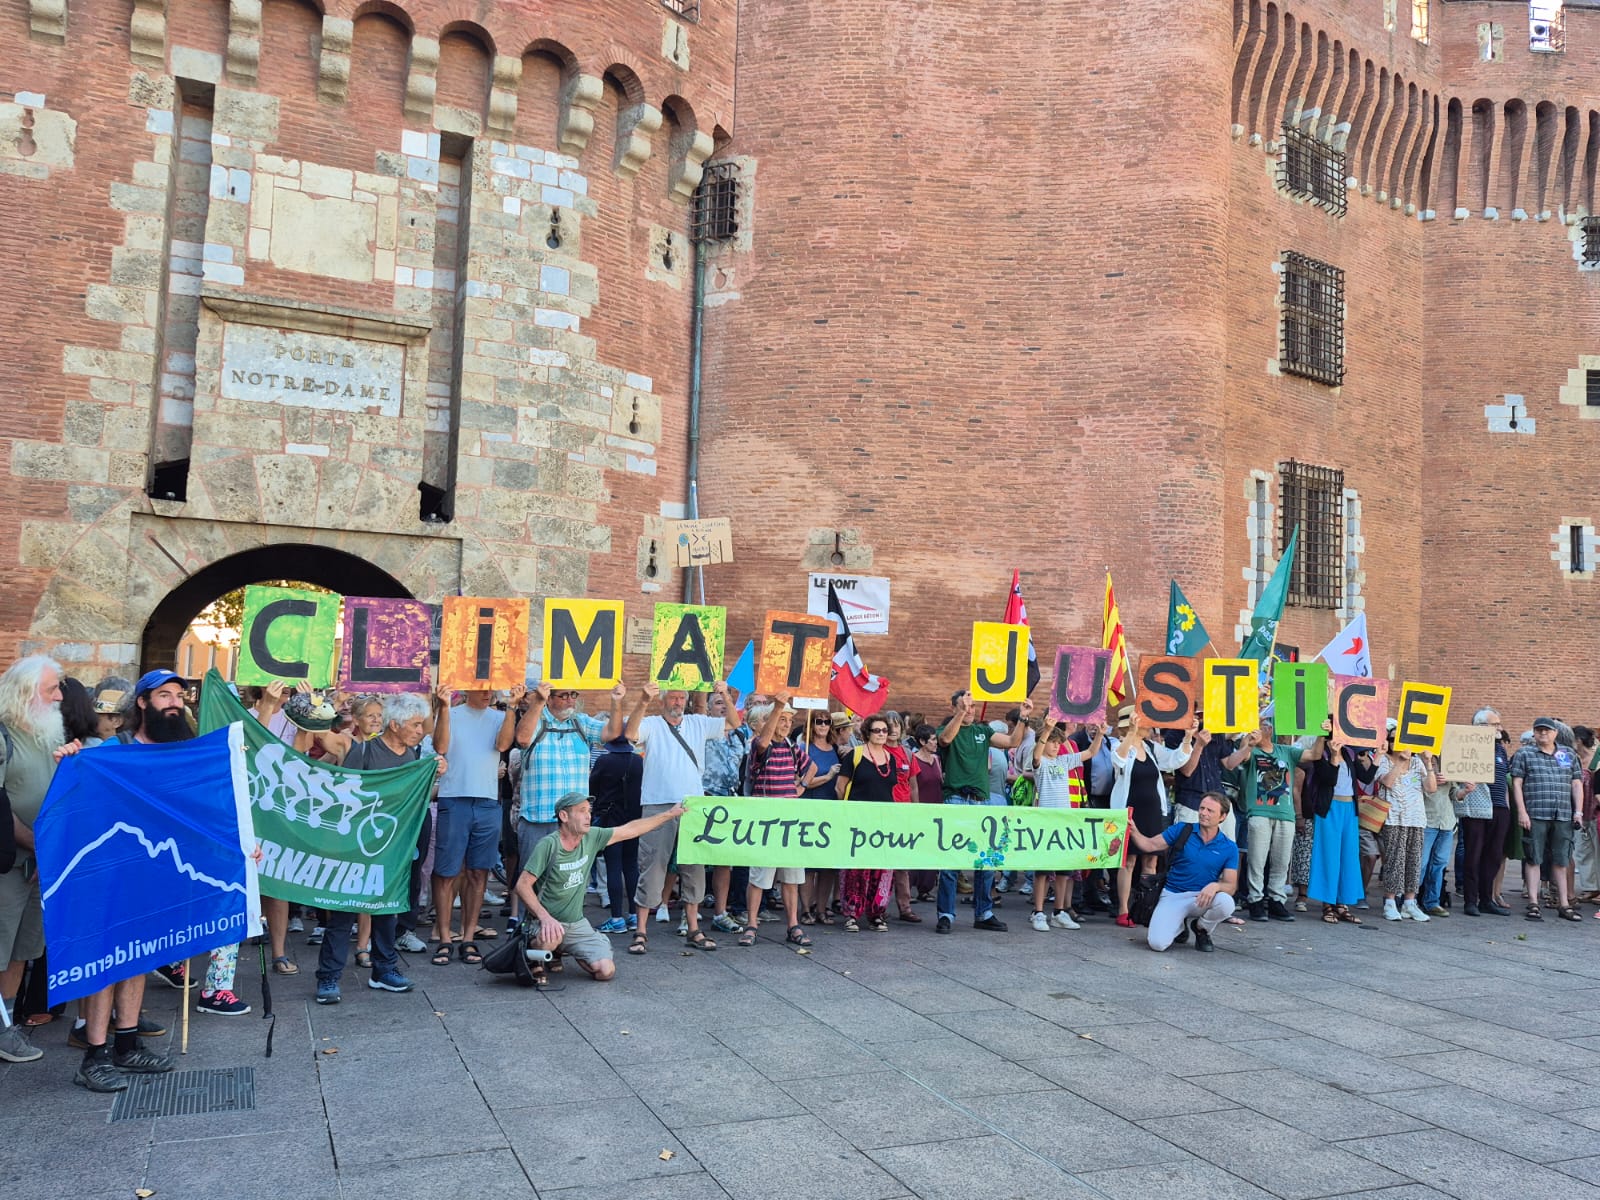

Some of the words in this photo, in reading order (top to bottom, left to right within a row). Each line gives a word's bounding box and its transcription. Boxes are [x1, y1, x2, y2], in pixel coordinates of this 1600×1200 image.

[274, 343, 354, 368] PORTE
[814, 578, 826, 588] LE
[1446, 761, 1494, 775] COURSE
[850, 827, 925, 857] pour
[933, 818, 971, 851] le
